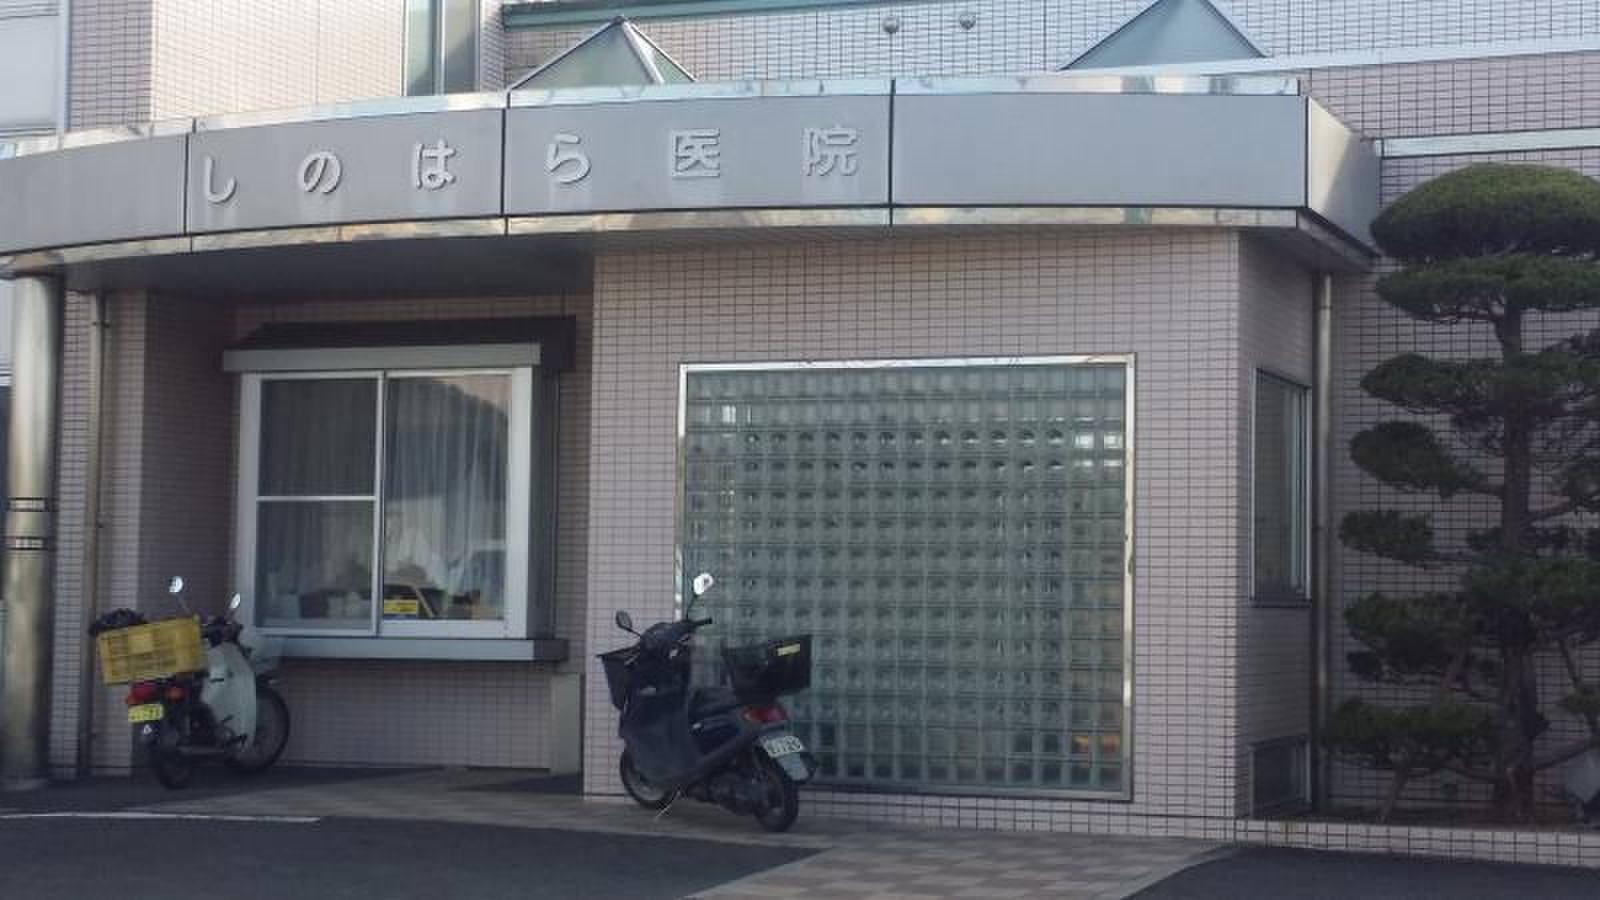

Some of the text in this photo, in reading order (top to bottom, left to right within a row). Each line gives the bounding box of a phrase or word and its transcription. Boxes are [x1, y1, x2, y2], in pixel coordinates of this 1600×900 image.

[203, 126, 860, 205] しのはら医院
